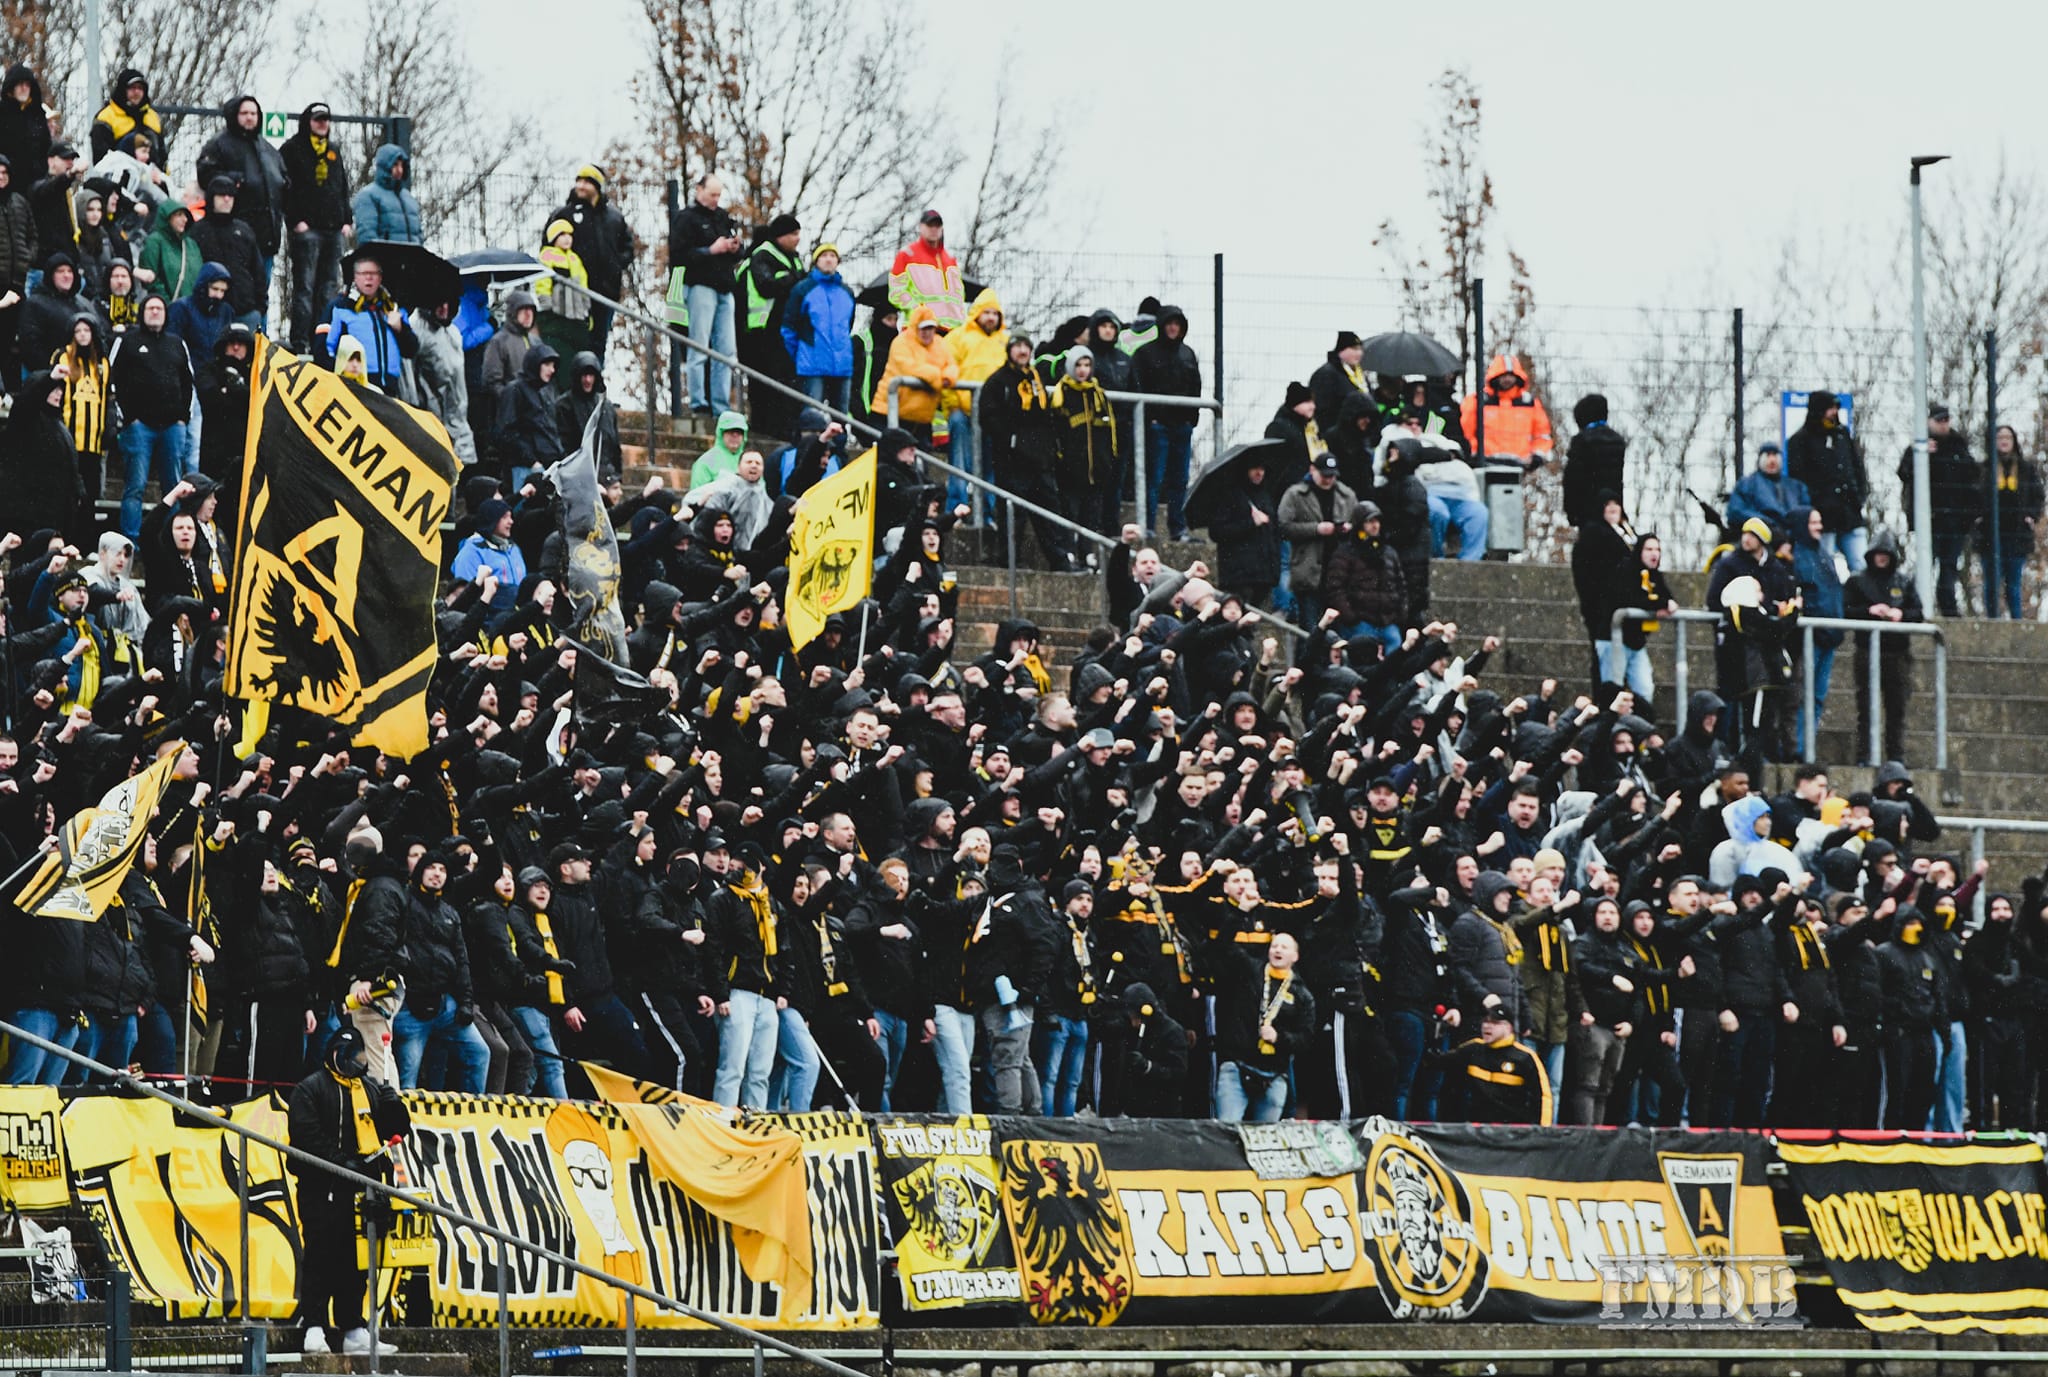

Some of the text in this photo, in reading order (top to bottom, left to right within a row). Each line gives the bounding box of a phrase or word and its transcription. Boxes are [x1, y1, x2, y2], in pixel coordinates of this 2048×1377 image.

[18, 1144, 58, 1160] REGEL
[1670, 1166, 1732, 1178] ALEMANNIA
[1117, 1186, 1356, 1278] KARLS
[1480, 1188, 1676, 1283] BANDE
